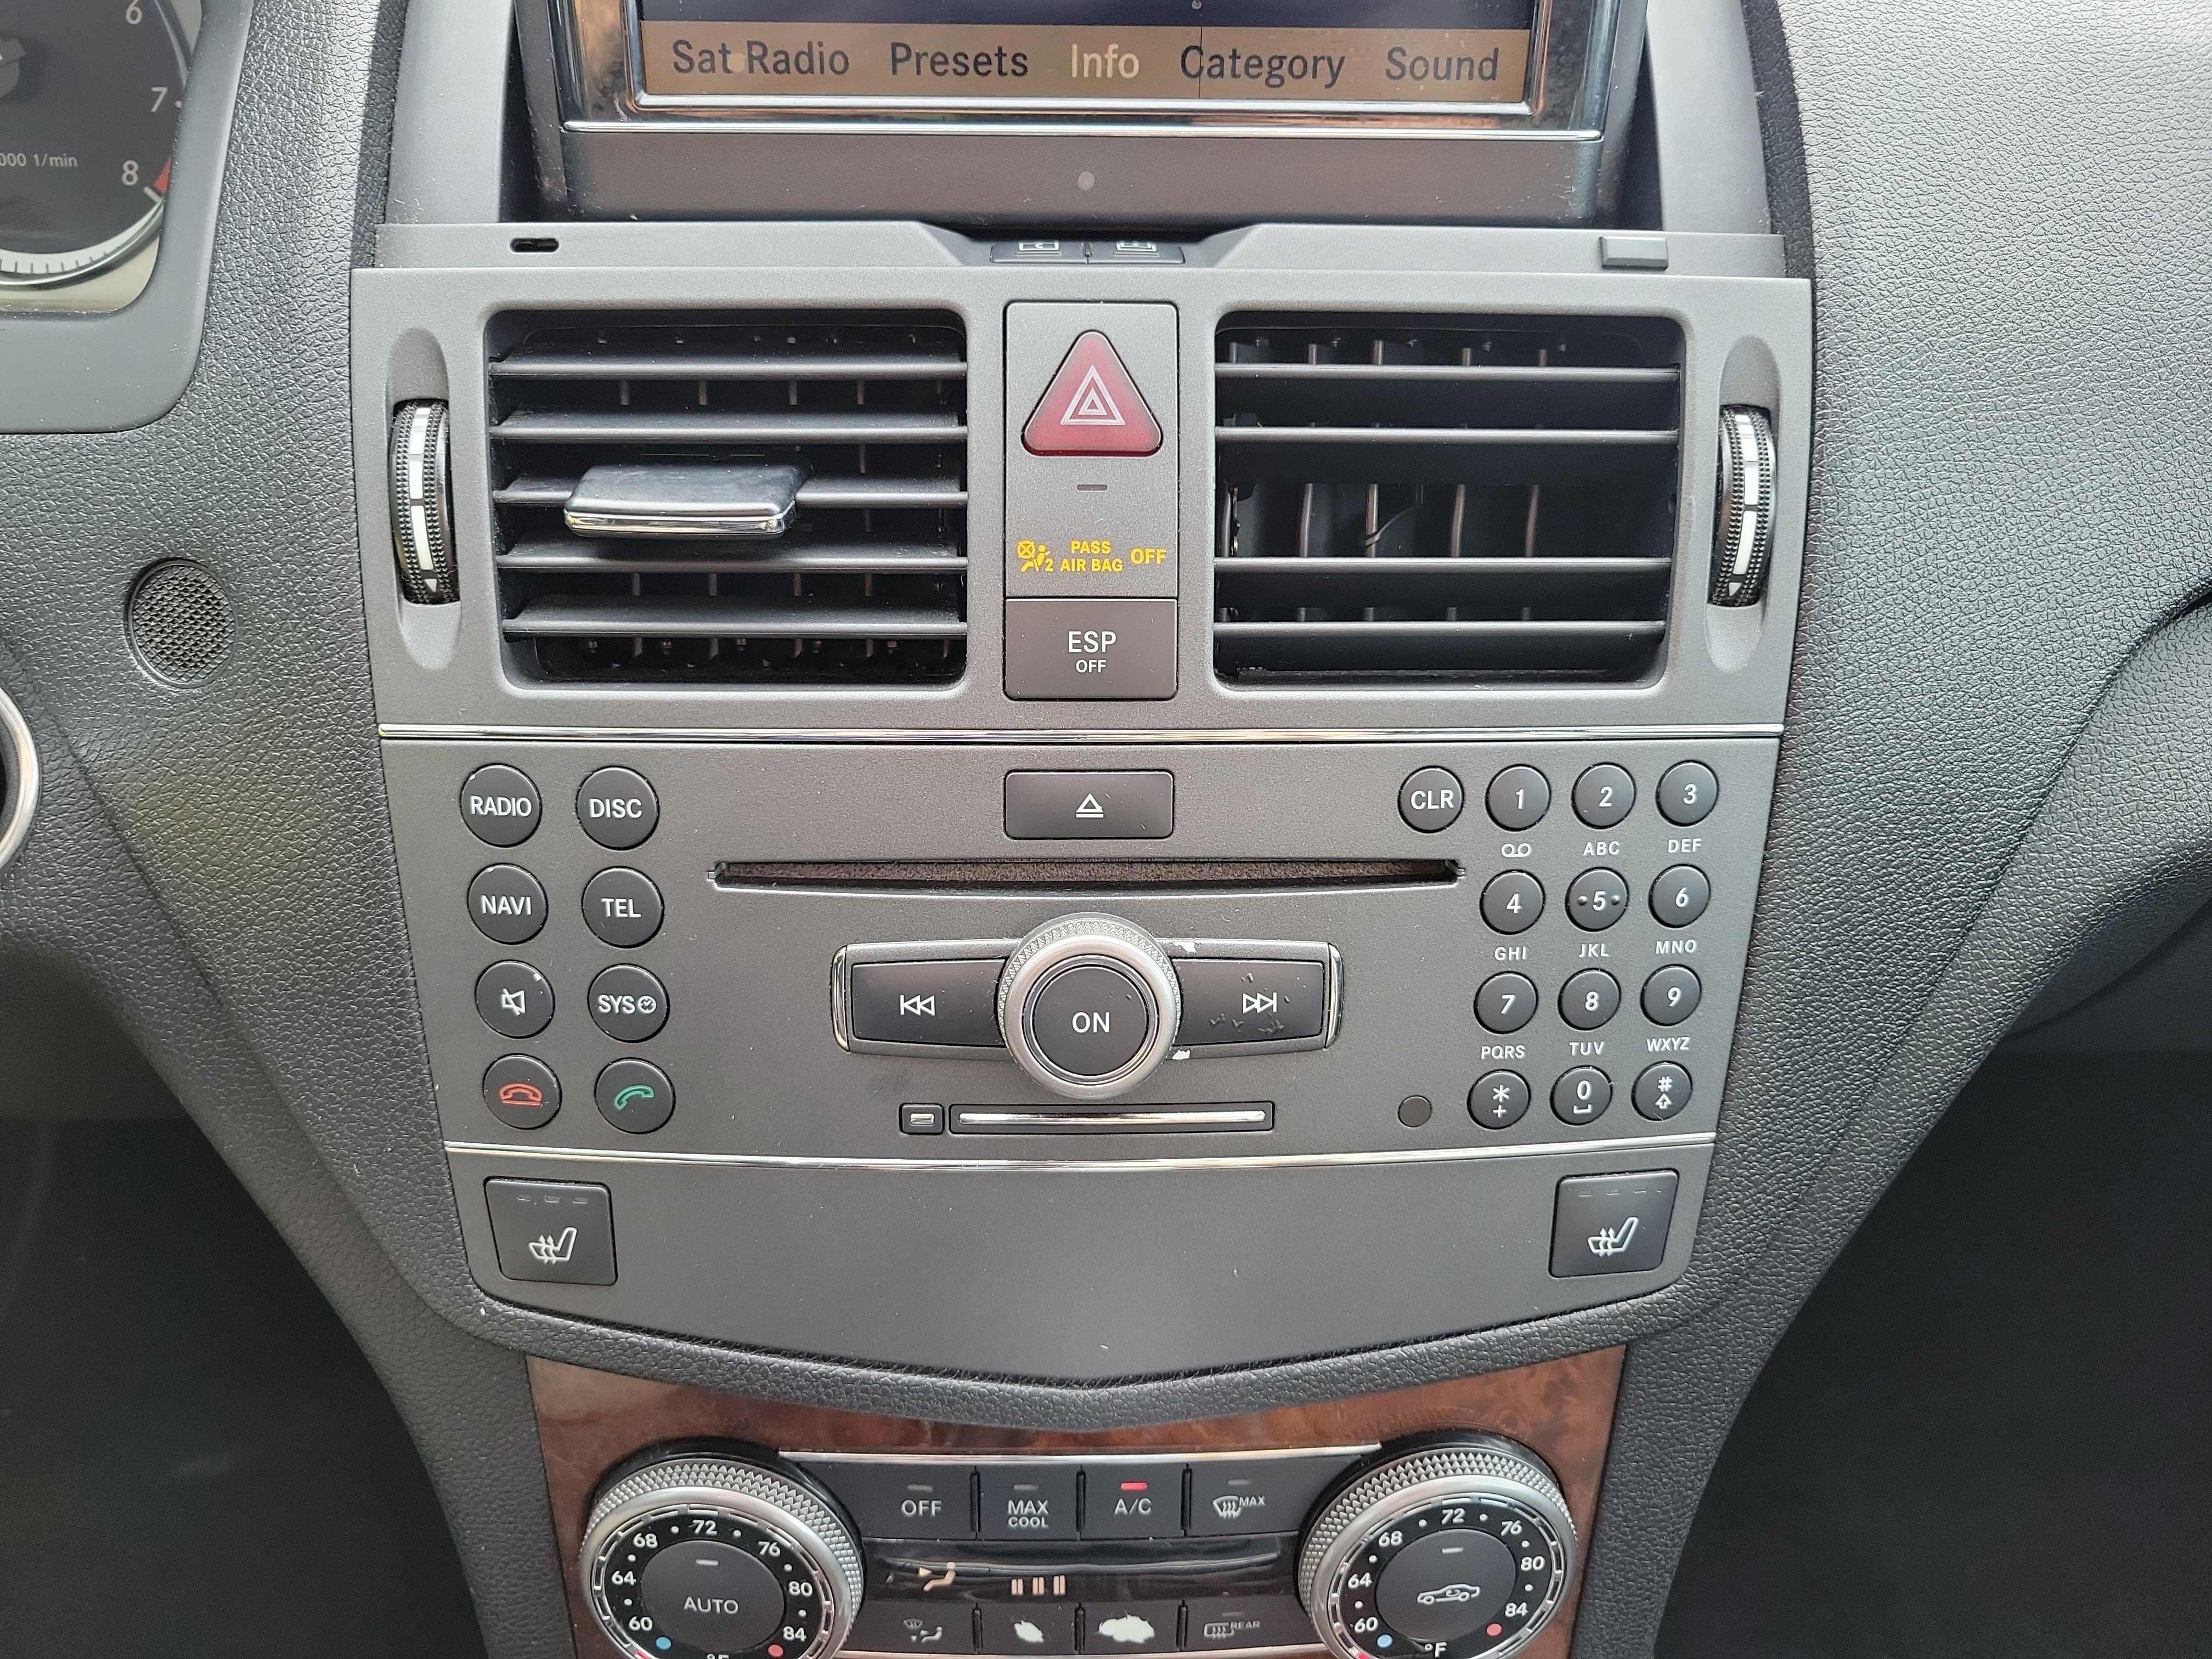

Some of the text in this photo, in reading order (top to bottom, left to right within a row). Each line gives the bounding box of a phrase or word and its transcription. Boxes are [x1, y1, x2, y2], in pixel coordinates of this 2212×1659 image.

[126, 0, 143, 25] 6
[673, 40, 850, 76] Sat Radio
[891, 42, 1028, 77] Presets
[1071, 43, 1139, 78] Info
[1385, 47, 1500, 81] Sound
[1180, 45, 1346, 89] Category
[151, 87, 168, 112] 7
[121, 160, 139, 186] 8
[1070, 540, 1111, 554] PASS
[1059, 557, 1124, 572] AIR BAG
[1130, 548, 1167, 565] OFF
[1068, 631, 1116, 653] ESP
[1076, 659, 1107, 673] OFF
[1411, 789, 1454, 810] CLR
[1516, 789, 1523, 809] 1
[1599, 786, 1613, 807] 2
[1683, 783, 1697, 804] 3
[470, 795, 532, 817] RADIO
[589, 798, 642, 818] DISC
[1583, 841, 1620, 856] ABC
[1668, 838, 1702, 853] DEF
[481, 895, 532, 915] NAVI
[1506, 893, 1521, 913] 4
[1593, 891, 1606, 911] 5
[1675, 887, 1689, 907] 6
[601, 898, 641, 918] TEL
[1494, 946, 1526, 961] GHI
[1578, 943, 1609, 957] JKL
[1656, 939, 1697, 955] MNO
[598, 995, 635, 1014] SYS
[1501, 994, 1515, 1014] 7
[1585, 991, 1599, 1011] 8
[1668, 987, 1681, 1007] 9
[1072, 1012, 1110, 1033] ON
[1481, 1045, 1525, 1059] PQRS
[1569, 1041, 1604, 1056] TUV
[1646, 1037, 1690, 1052] WXYZ
[1577, 1080, 1592, 1100] 0
[901, 1500, 941, 1516] OFF
[1008, 1500, 1048, 1515] MAX
[1114, 1498, 1151, 1515] A/C
[1239, 1496, 1265, 1506] MAX
[1008, 1516, 1048, 1528] COOL
[1441, 1508, 1465, 1524] 72
[692, 1519, 718, 1535] 72
[1500, 1520, 1522, 1536] 76
[633, 1533, 658, 1548] 68
[1378, 1531, 1403, 1547] 68
[758, 1541, 781, 1558] 76
[1520, 1556, 1545, 1571] 80
[611, 1570, 636, 1585] 64
[1347, 1573, 1372, 1588] 64
[788, 1581, 813, 1597] 80
[684, 1596, 738, 1614] AUTO
[1505, 1602, 1528, 1617] 84
[629, 1616, 653, 1631] 60
[1231, 1621, 1260, 1630] REAR
[1354, 1617, 1378, 1633] 60
[783, 1626, 806, 1642] 84
